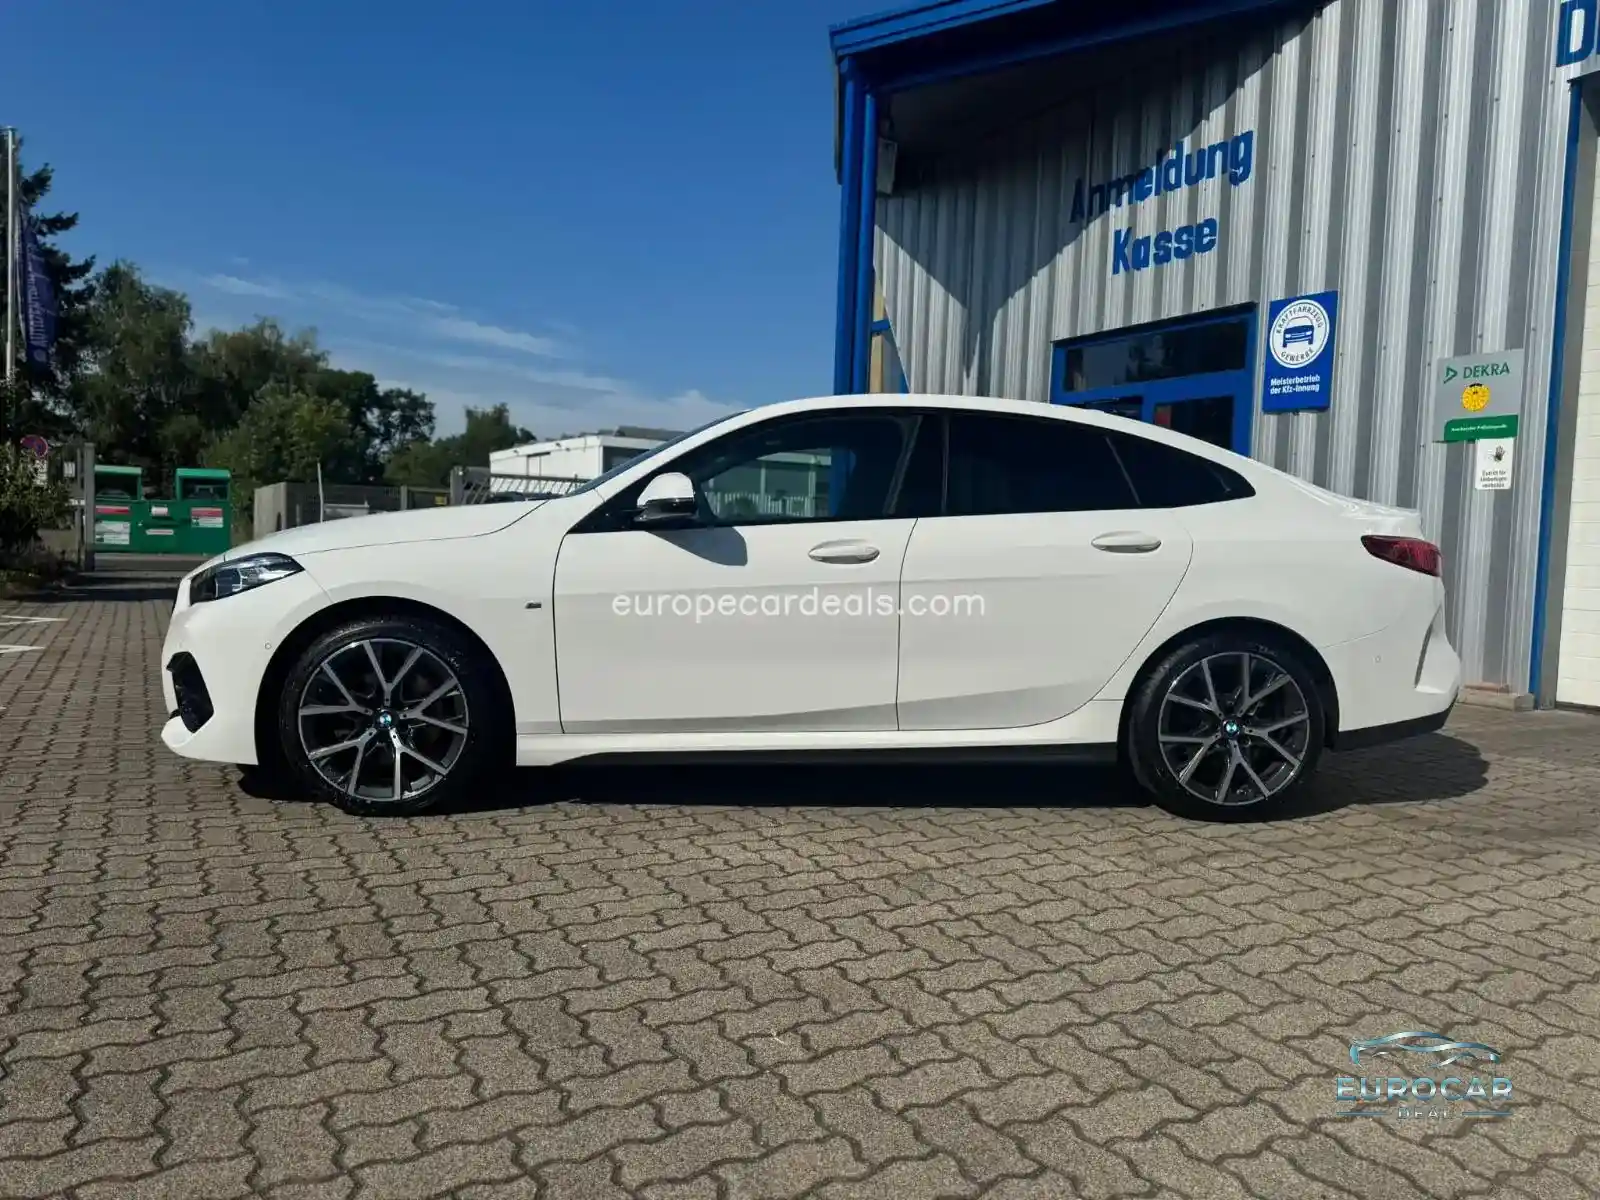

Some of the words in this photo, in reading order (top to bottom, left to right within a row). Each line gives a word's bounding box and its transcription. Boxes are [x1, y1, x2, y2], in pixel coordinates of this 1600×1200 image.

[1069, 130, 1254, 223] Anmeldung
[1112, 217, 1218, 275] Kasse
[1270, 374, 1320, 386] Meisterbetrieb
[1463, 362, 1510, 379] DEKRA
